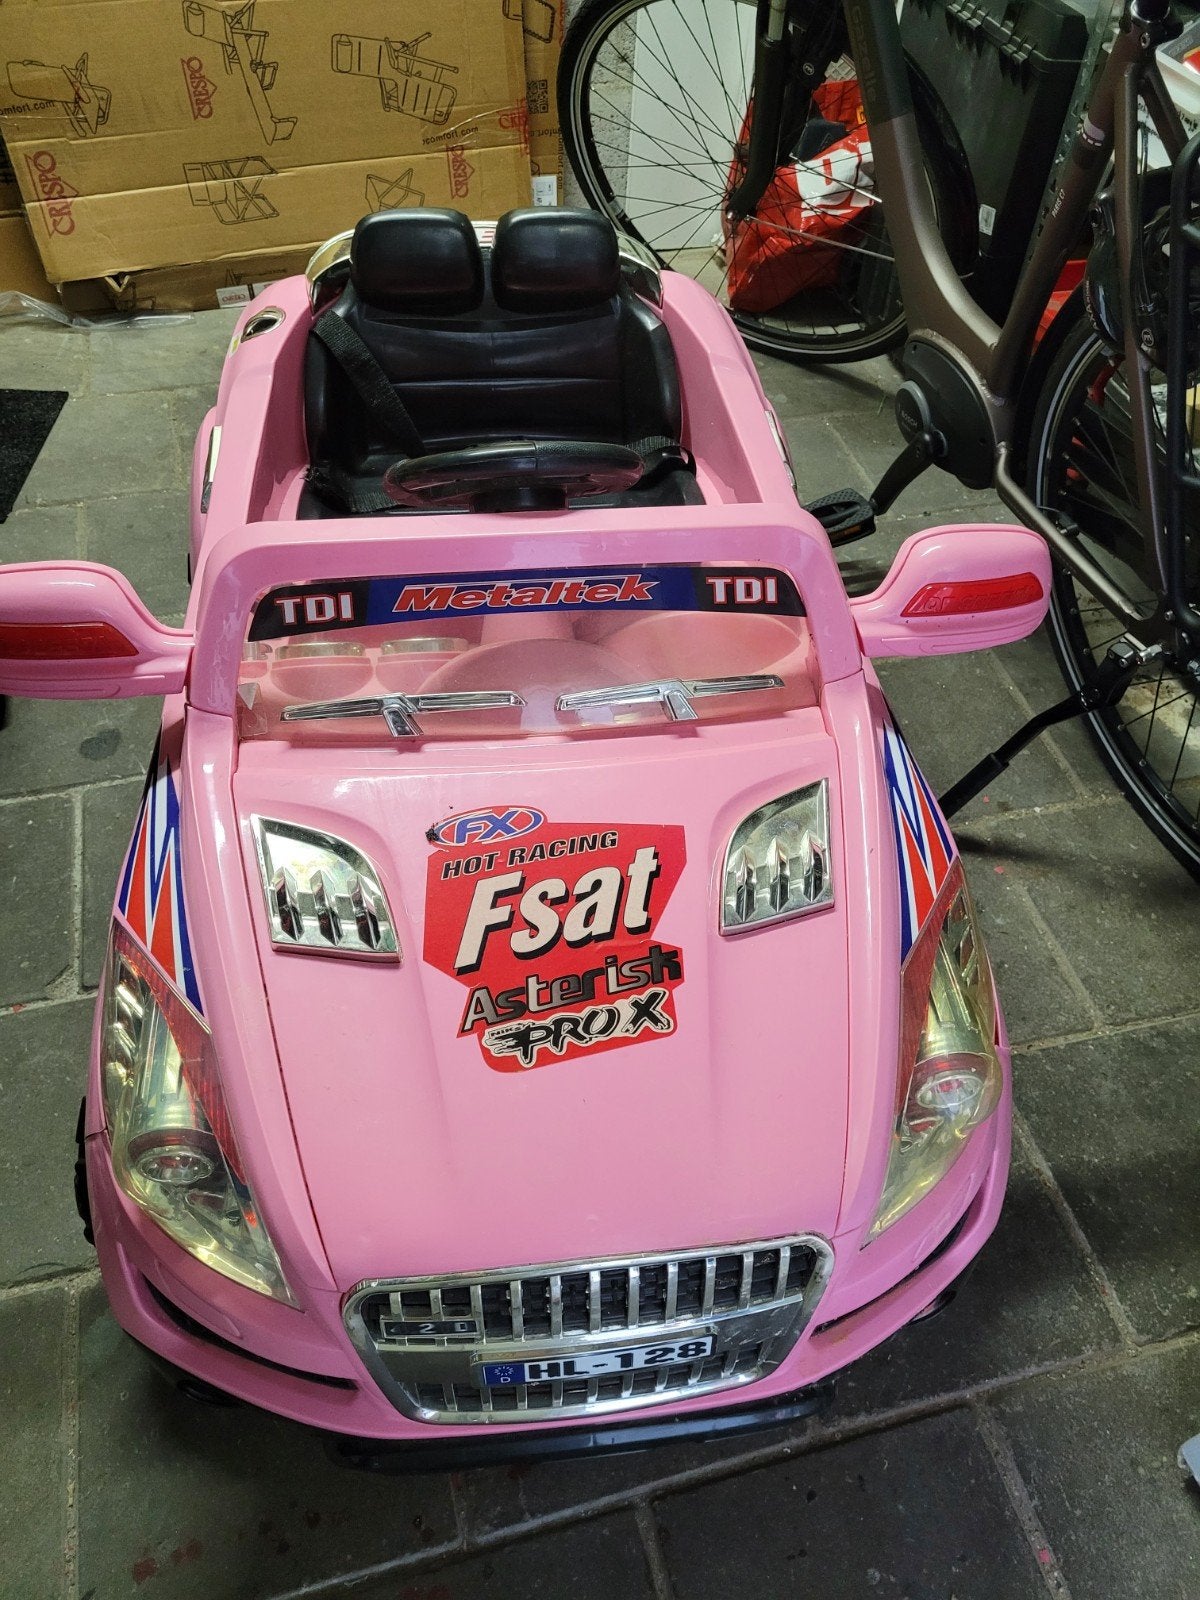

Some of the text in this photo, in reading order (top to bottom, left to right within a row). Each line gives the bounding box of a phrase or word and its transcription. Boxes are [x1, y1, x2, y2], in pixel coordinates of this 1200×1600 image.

[187, 56, 213, 119] CRESPO
[33, 151, 76, 236] CRESPO
[451, 145, 469, 198] CRESPO
[275, 574, 778, 625] TDI Metaltek TDI
[454, 808, 522, 845] FX
[440, 831, 619, 880] HOT RACING
[453, 846, 662, 976] Fsat
[460, 945, 683, 1034] Asterisk
[500, 1341, 707, 1384] D HL-128
